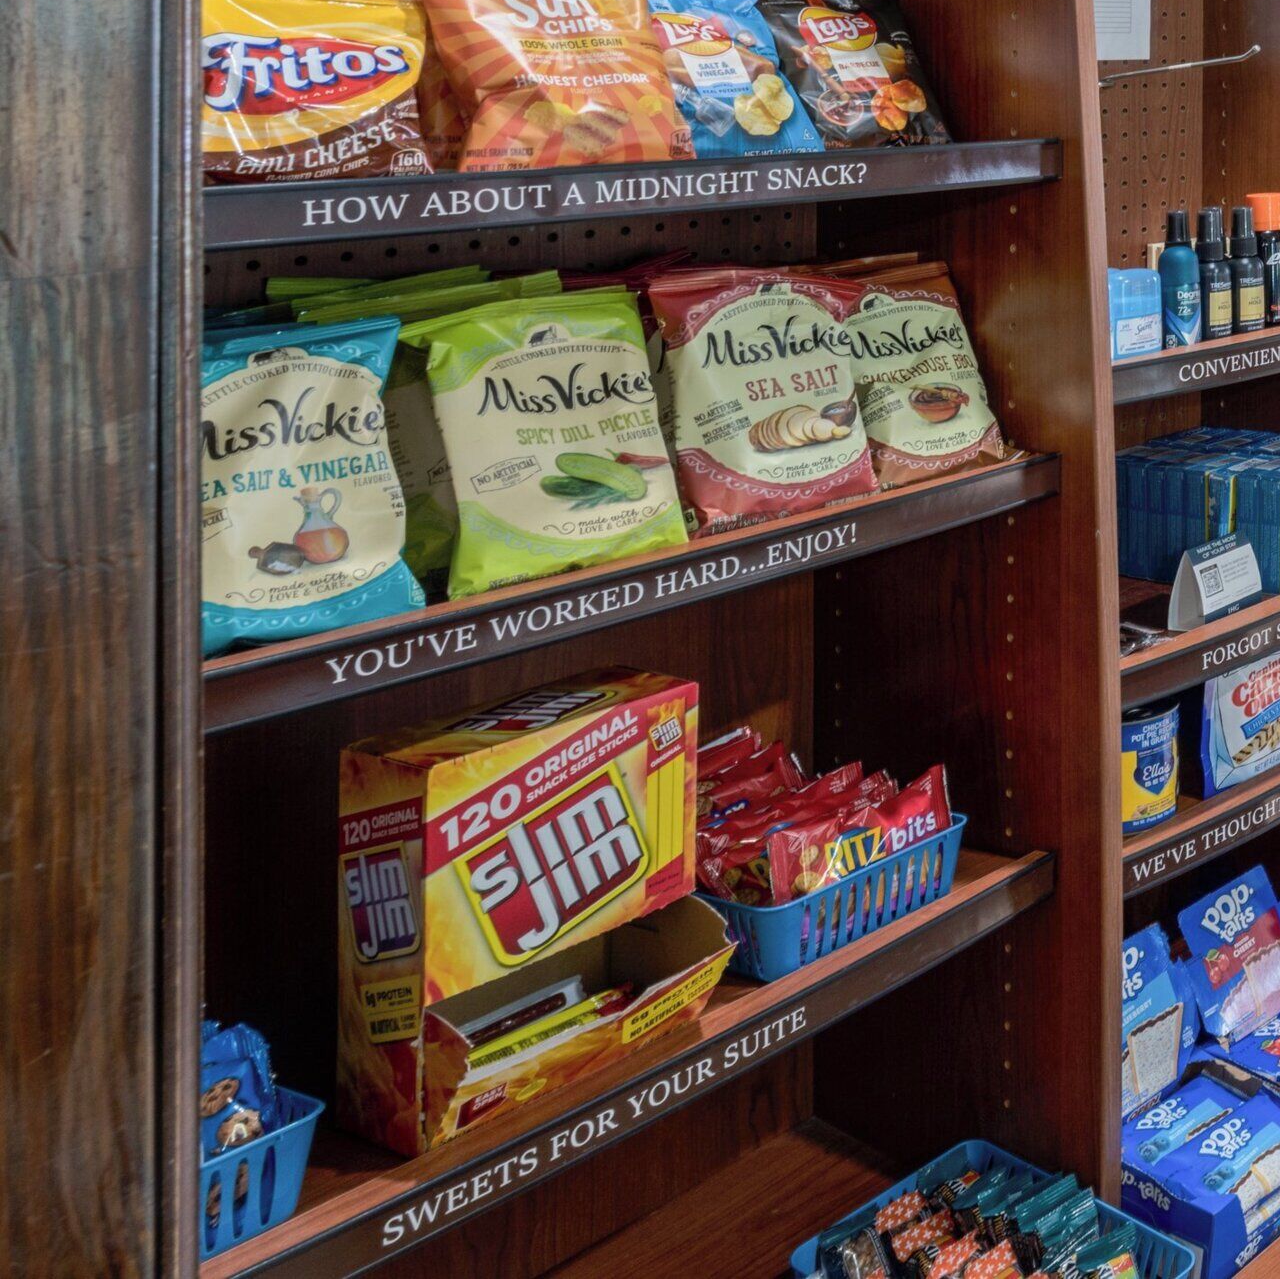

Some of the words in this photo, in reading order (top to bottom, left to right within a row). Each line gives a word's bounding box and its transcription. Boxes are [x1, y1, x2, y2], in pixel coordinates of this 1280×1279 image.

[544, 18, 613, 35] CHIPS
[806, 16, 870, 43] Lay's
[519, 40, 547, 51] 100%
[549, 39, 590, 50] WHOLE
[591, 38, 623, 48] GRAIN
[202, 33, 409, 111] Fritos
[514, 74, 577, 88] HARVEST
[583, 73, 650, 87] CHEDDAR
[697, 68, 738, 78] VINEGAR
[698, 62, 720, 71] SALT
[235, 153, 295, 175] CHILI
[304, 118, 396, 168] CHEESE
[397, 152, 423, 167] 160
[313, 167, 339, 179] CORN
[342, 156, 370, 172] CHIPS
[302, 194, 410, 227] HOW
[421, 184, 552, 217] ABOUT
[562, 182, 586, 206] A
[596, 170, 759, 204] MIDNIGHT
[768, 163, 868, 191] SNACK?
[701, 329, 773, 369] Miss
[881, 319, 963, 354] Vickie's
[521, 347, 557, 363] COOKED
[558, 344, 592, 355] POTATO
[594, 344, 622, 354] CHIPS
[242, 364, 289, 386] COOKED
[292, 362, 328, 375] POTATO
[329, 366, 358, 379] CHIPS
[745, 377, 786, 402] SEA
[790, 364, 838, 393] SALT
[862, 355, 951, 384] SMOKEHOUSE
[953, 354, 975, 370] BBQ
[477, 376, 557, 416] Miss
[516, 427, 555, 446] SPICY
[560, 424, 595, 445] DILL
[598, 408, 654, 435] PICKLE
[616, 426, 659, 444] FLAVORED
[232, 469, 273, 493] SALT
[278, 469, 296, 489] &
[297, 451, 390, 484] VINEGAR
[353, 473, 392, 488] FLAVORED
[477, 473, 491, 486] NO
[492, 459, 537, 479] ARTIFICIAL
[578, 516, 608, 528] made
[611, 508, 640, 522] with
[579, 523, 604, 535] LOVE
[269, 580, 305, 594] made
[309, 571, 349, 588] with
[269, 589, 299, 603] LOVE
[316, 581, 347, 595] CARE
[1227, 603, 1240, 614] IHG
[325, 623, 479, 684] YOU'VE
[489, 581, 645, 641] WORKED
[1201, 627, 1272, 670] FORGOT
[526, 772, 568, 804] SNACK
[570, 752, 597, 776] SIZE
[597, 726, 638, 757] STICKS
[650, 744, 682, 769] ORIGINAL
[439, 784, 522, 851] 120
[525, 709, 638, 787] ORIGINAL
[343, 819, 371, 845] 120
[371, 807, 418, 829] ORIGINAL
[824, 826, 887, 878] RITZ
[891, 809, 937, 853] bits
[1132, 839, 1197, 882] WE'VE
[1220, 906, 1256, 943] tarts
[376, 987, 412, 1002] PROTEIN
[630, 1027, 642, 1038] NO
[643, 999, 685, 1031] ARTIFICIAL
[382, 1149, 537, 1247] SWEETS
[549, 1108, 619, 1161] FOR
[627, 1058, 715, 1120] YOUR
[723, 1006, 808, 1068] SUITE
[1218, 1129, 1251, 1159] tarts
